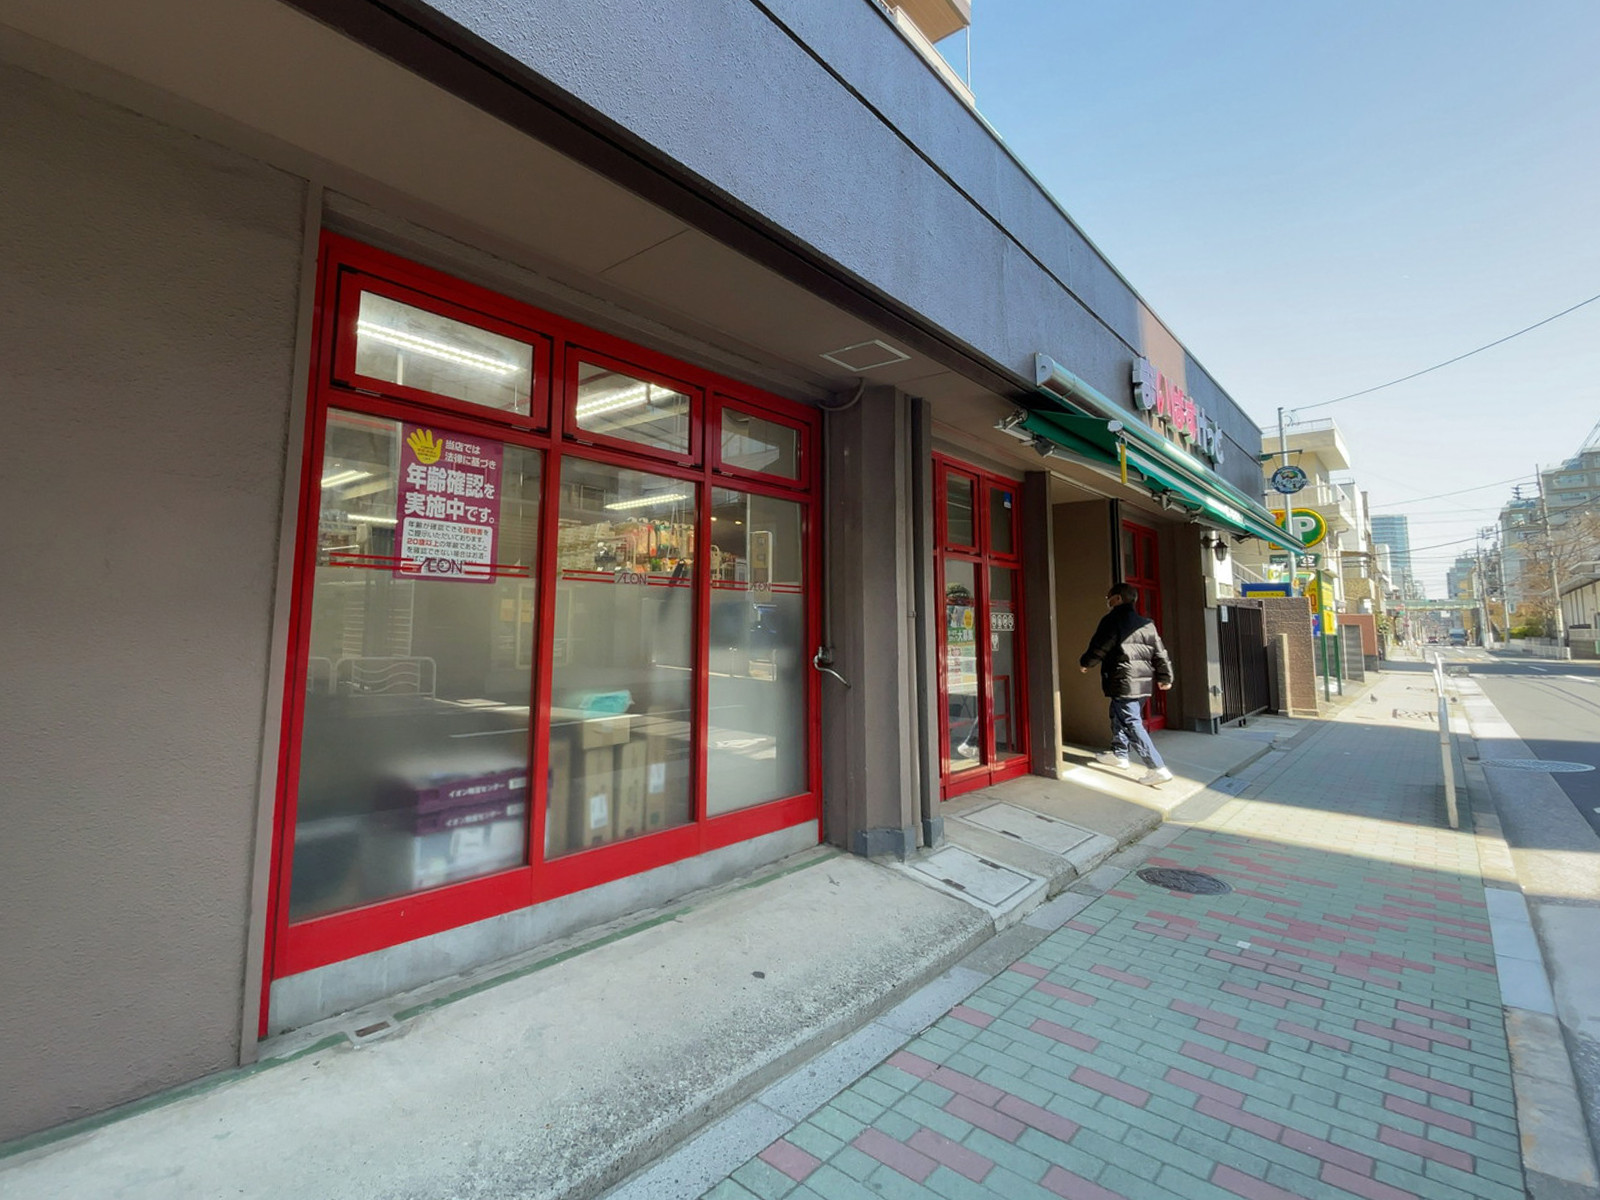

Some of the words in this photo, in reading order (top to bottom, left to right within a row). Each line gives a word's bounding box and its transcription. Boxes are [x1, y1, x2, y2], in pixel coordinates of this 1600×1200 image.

[445, 440, 481, 455] 当店では
[445, 452, 496, 470] 法律に基づき
[406, 463, 495, 499] 年齢確認を
[404, 491, 495, 524] 実施中です。
